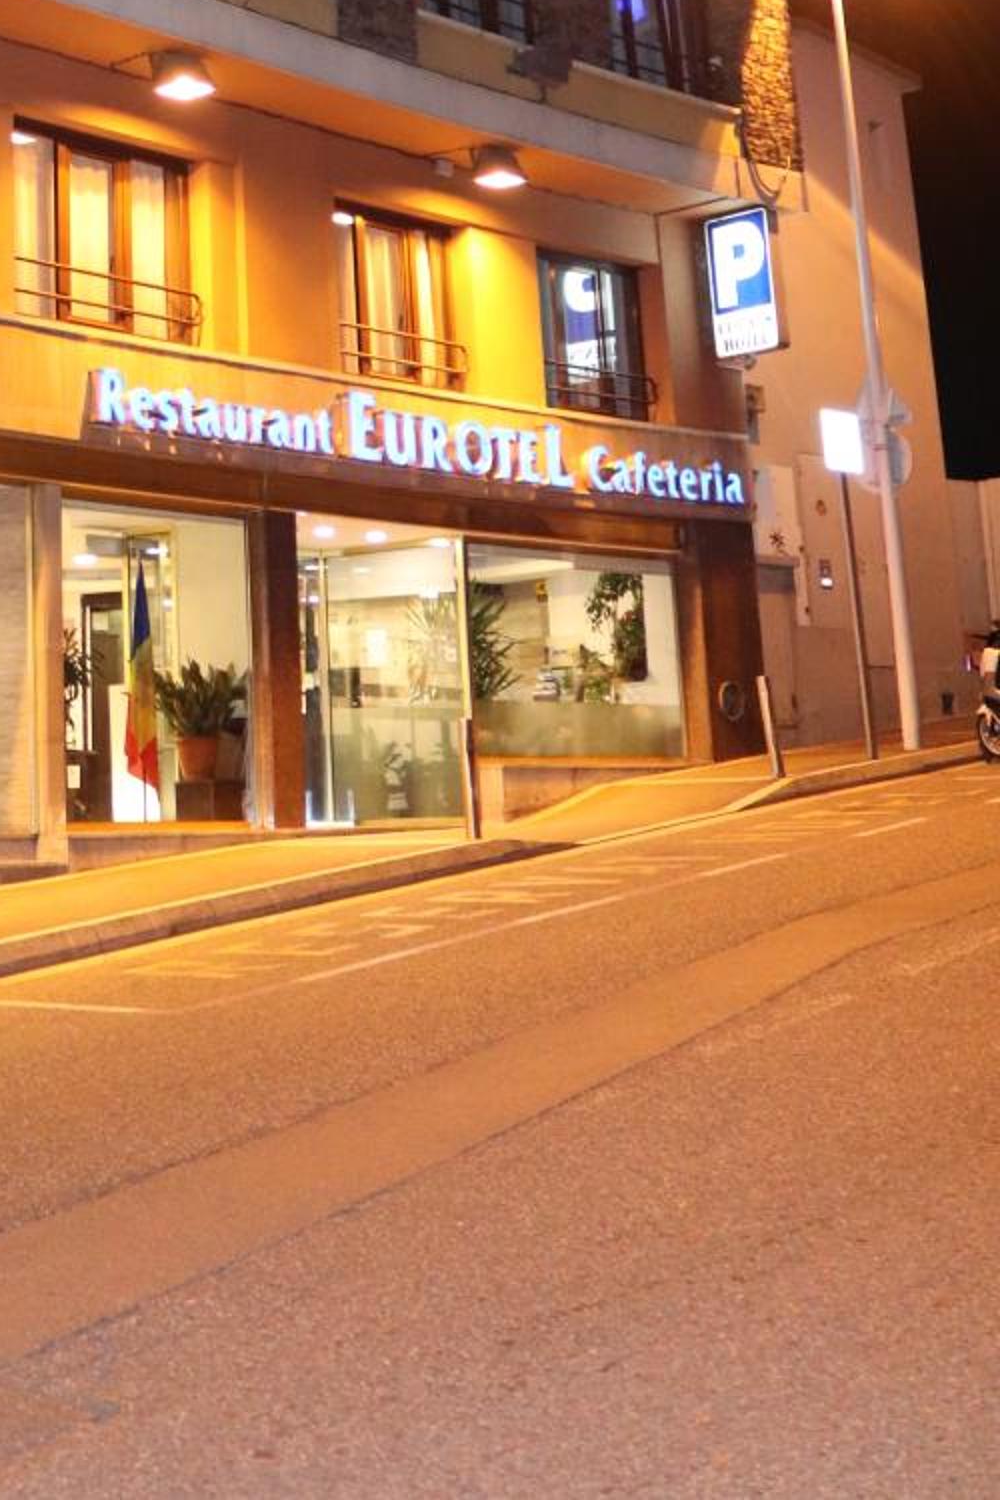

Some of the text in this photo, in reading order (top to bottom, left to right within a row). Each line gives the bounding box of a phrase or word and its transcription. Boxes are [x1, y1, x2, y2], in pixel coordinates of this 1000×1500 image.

[711, 220, 765, 309] P
[93, 367, 745, 504] Restaurant EUROTEL Cafeteria
